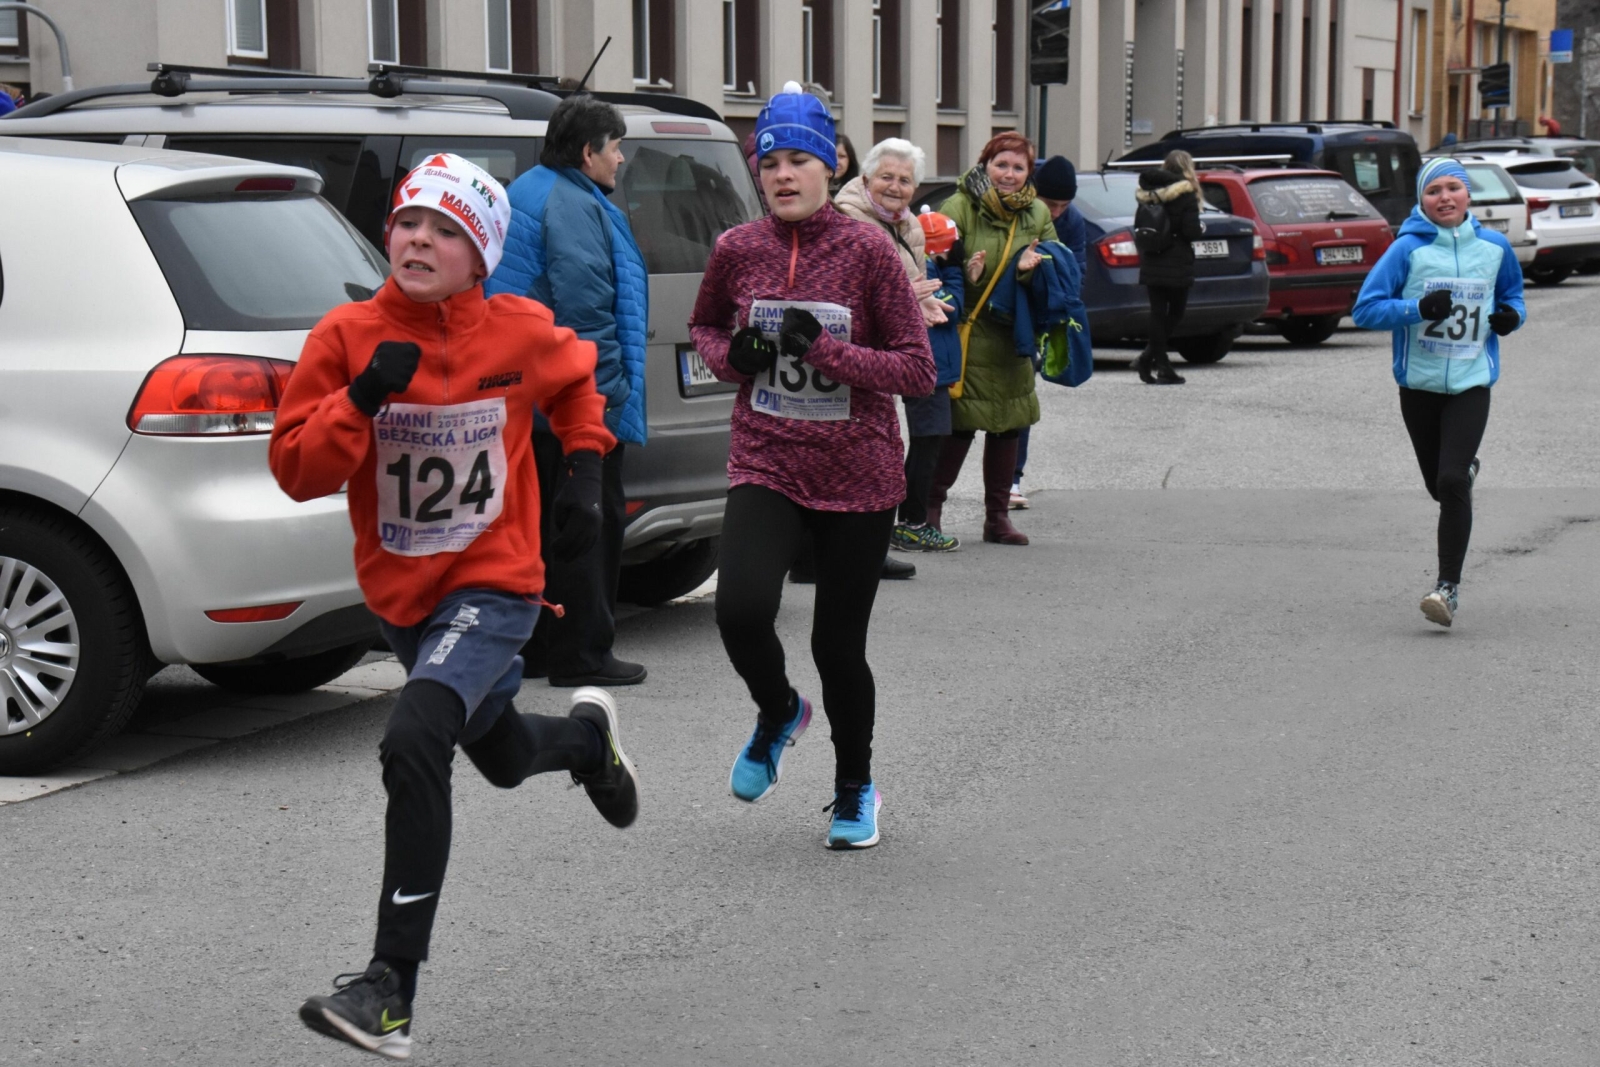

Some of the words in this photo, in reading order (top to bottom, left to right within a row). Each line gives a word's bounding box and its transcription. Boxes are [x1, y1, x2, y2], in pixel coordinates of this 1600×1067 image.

[471, 178, 496, 208] LES
[439, 190, 489, 251] MARATON
[753, 307, 785, 319] ZIMN
[1424, 304, 1480, 341] 231
[823, 323, 848, 334] IGA
[377, 411, 432, 428] ZIMNÍ
[438, 413, 499, 429] 2020-2021
[378, 427, 456, 447] BĚŽECKÁ
[464, 425, 497, 444] LIGA
[386, 449, 495, 522] 124
